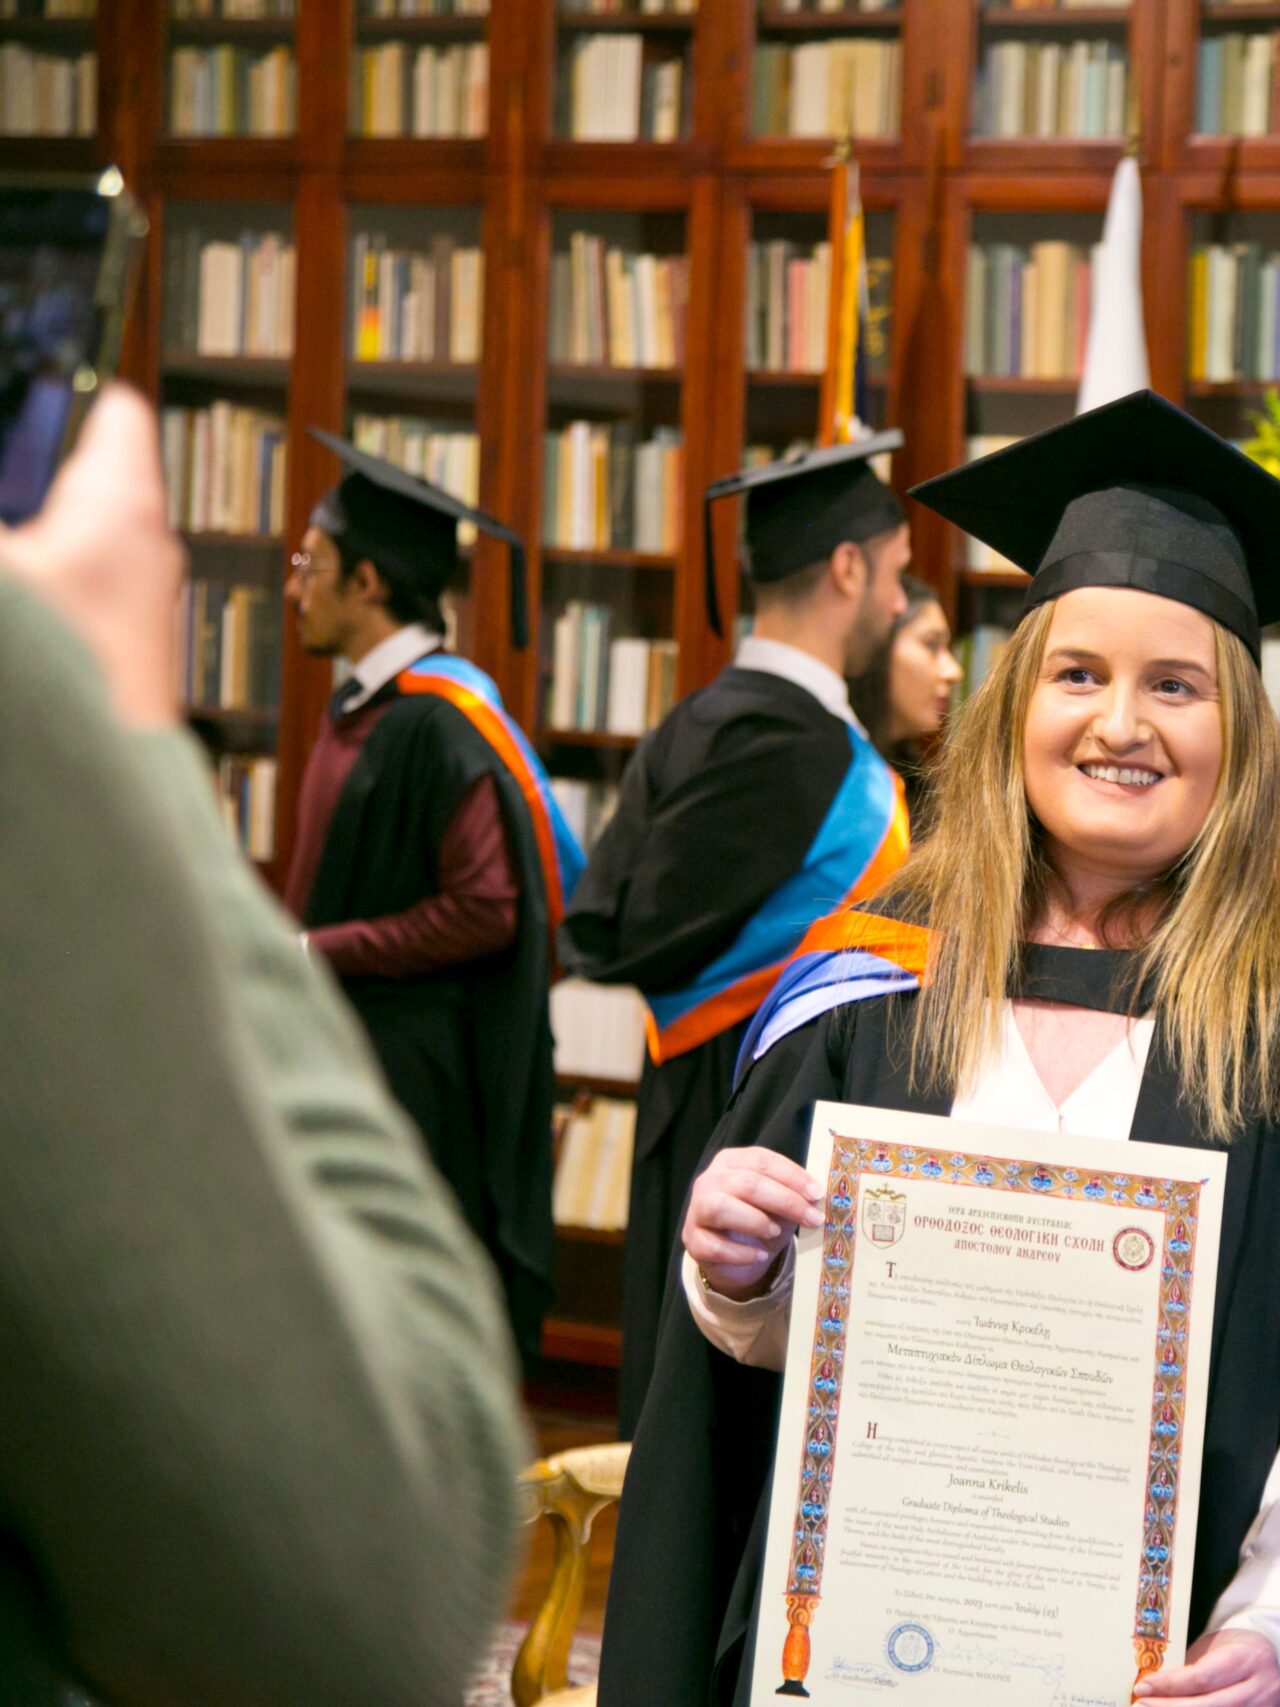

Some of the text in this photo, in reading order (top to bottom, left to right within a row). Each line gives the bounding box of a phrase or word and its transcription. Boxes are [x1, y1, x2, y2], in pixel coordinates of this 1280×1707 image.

[945, 1472, 1028, 1494] Joanna Krikelis
[901, 1496, 1069, 1527] Graduate Diploma of Theological Studies
